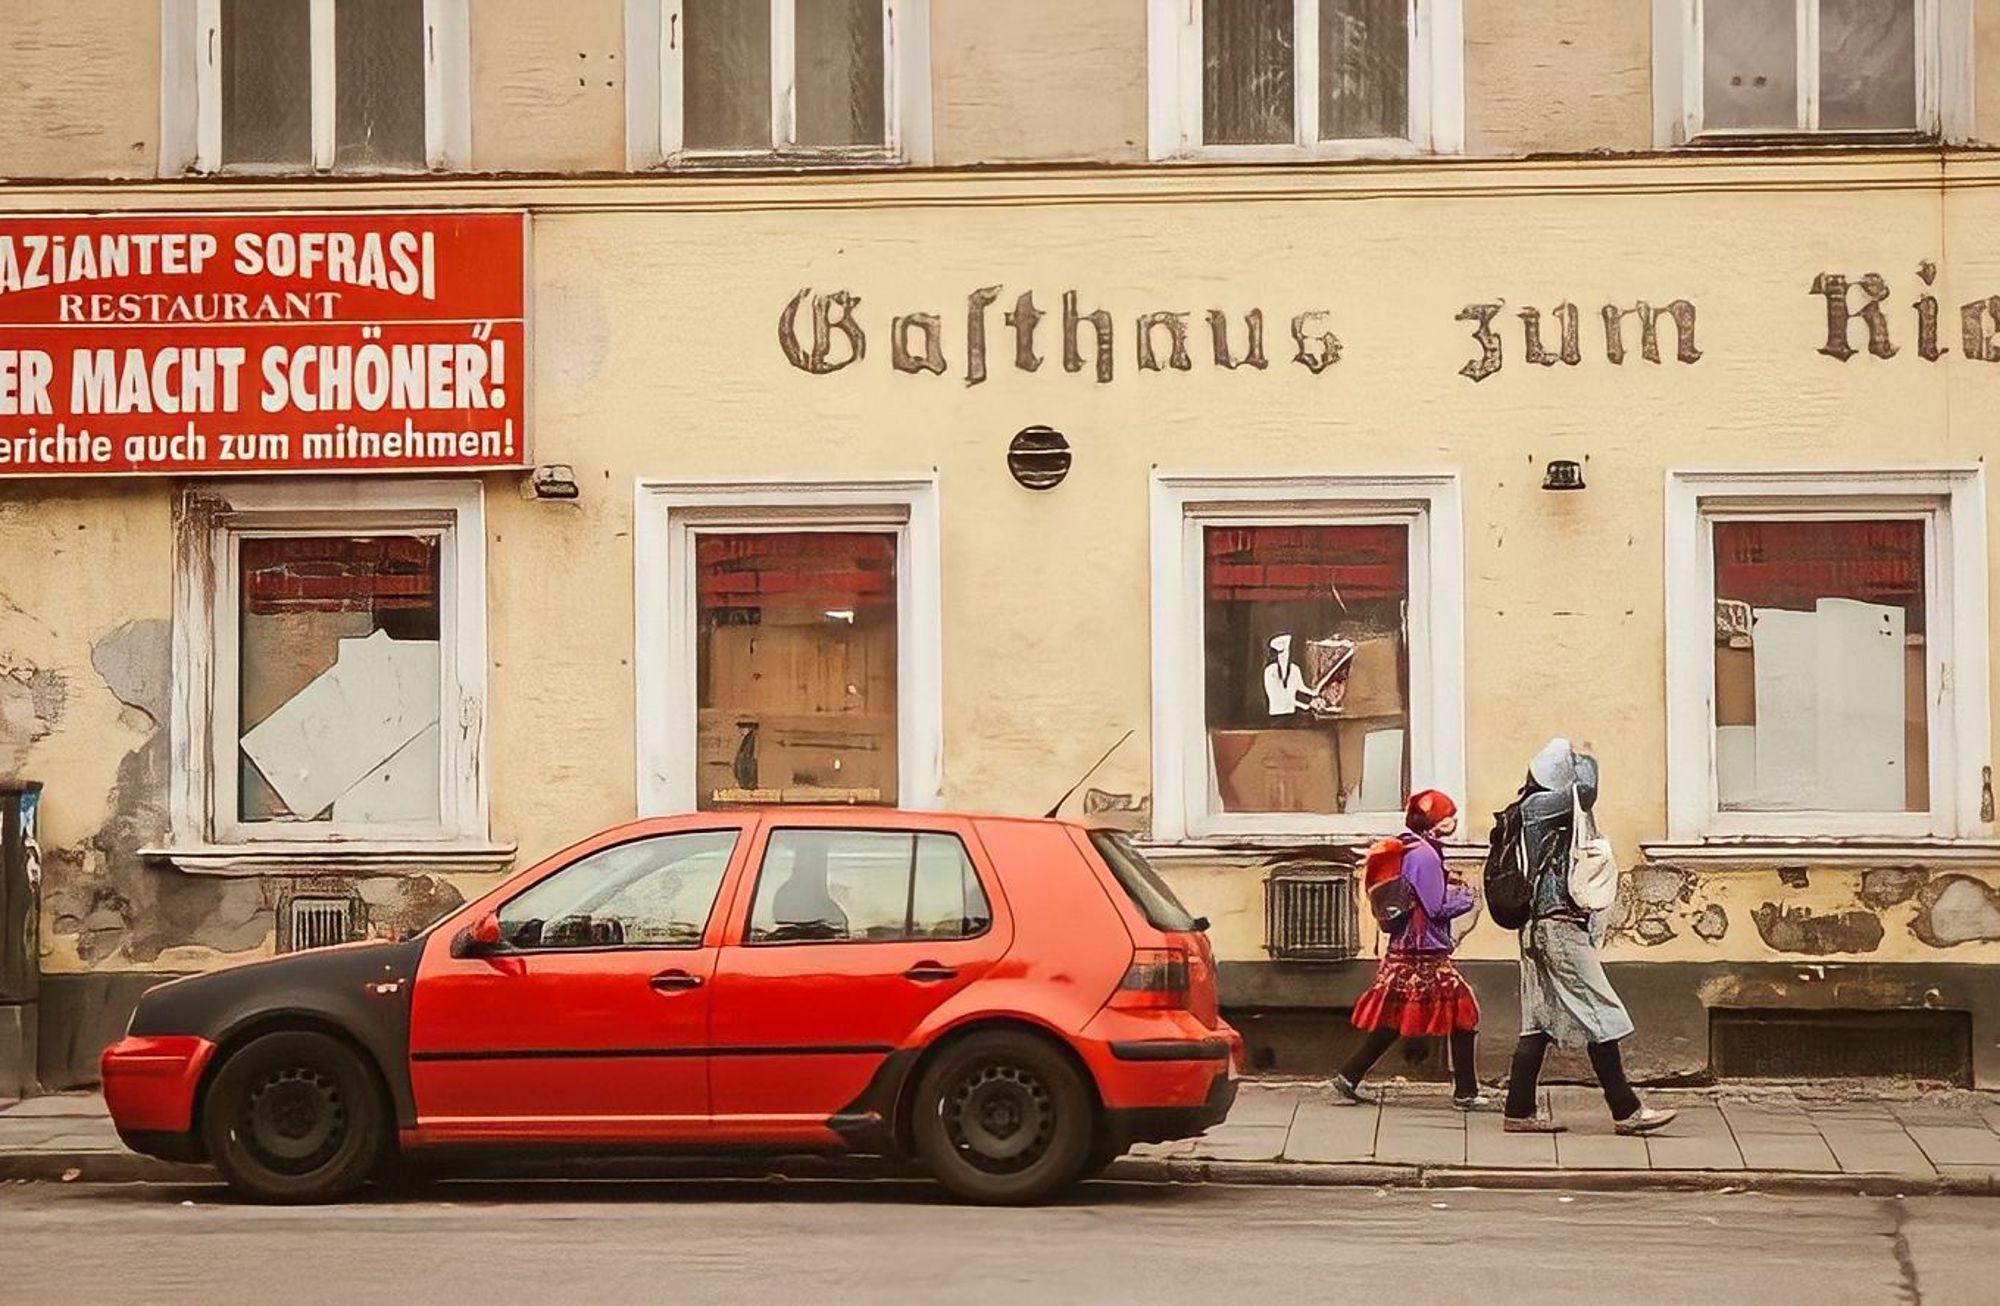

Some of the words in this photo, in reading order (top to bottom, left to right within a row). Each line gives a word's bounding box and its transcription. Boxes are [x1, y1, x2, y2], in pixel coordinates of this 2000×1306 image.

[234, 231, 436, 300] SOFRASI
[59, 292, 342, 322] RESTAURANT
[1455, 298, 1704, 382] zum
[71, 346, 246, 415] MACHT
[124, 421, 206, 463] auch
[218, 433, 290, 460] zum
[303, 417, 514, 457] mitnehmen!
